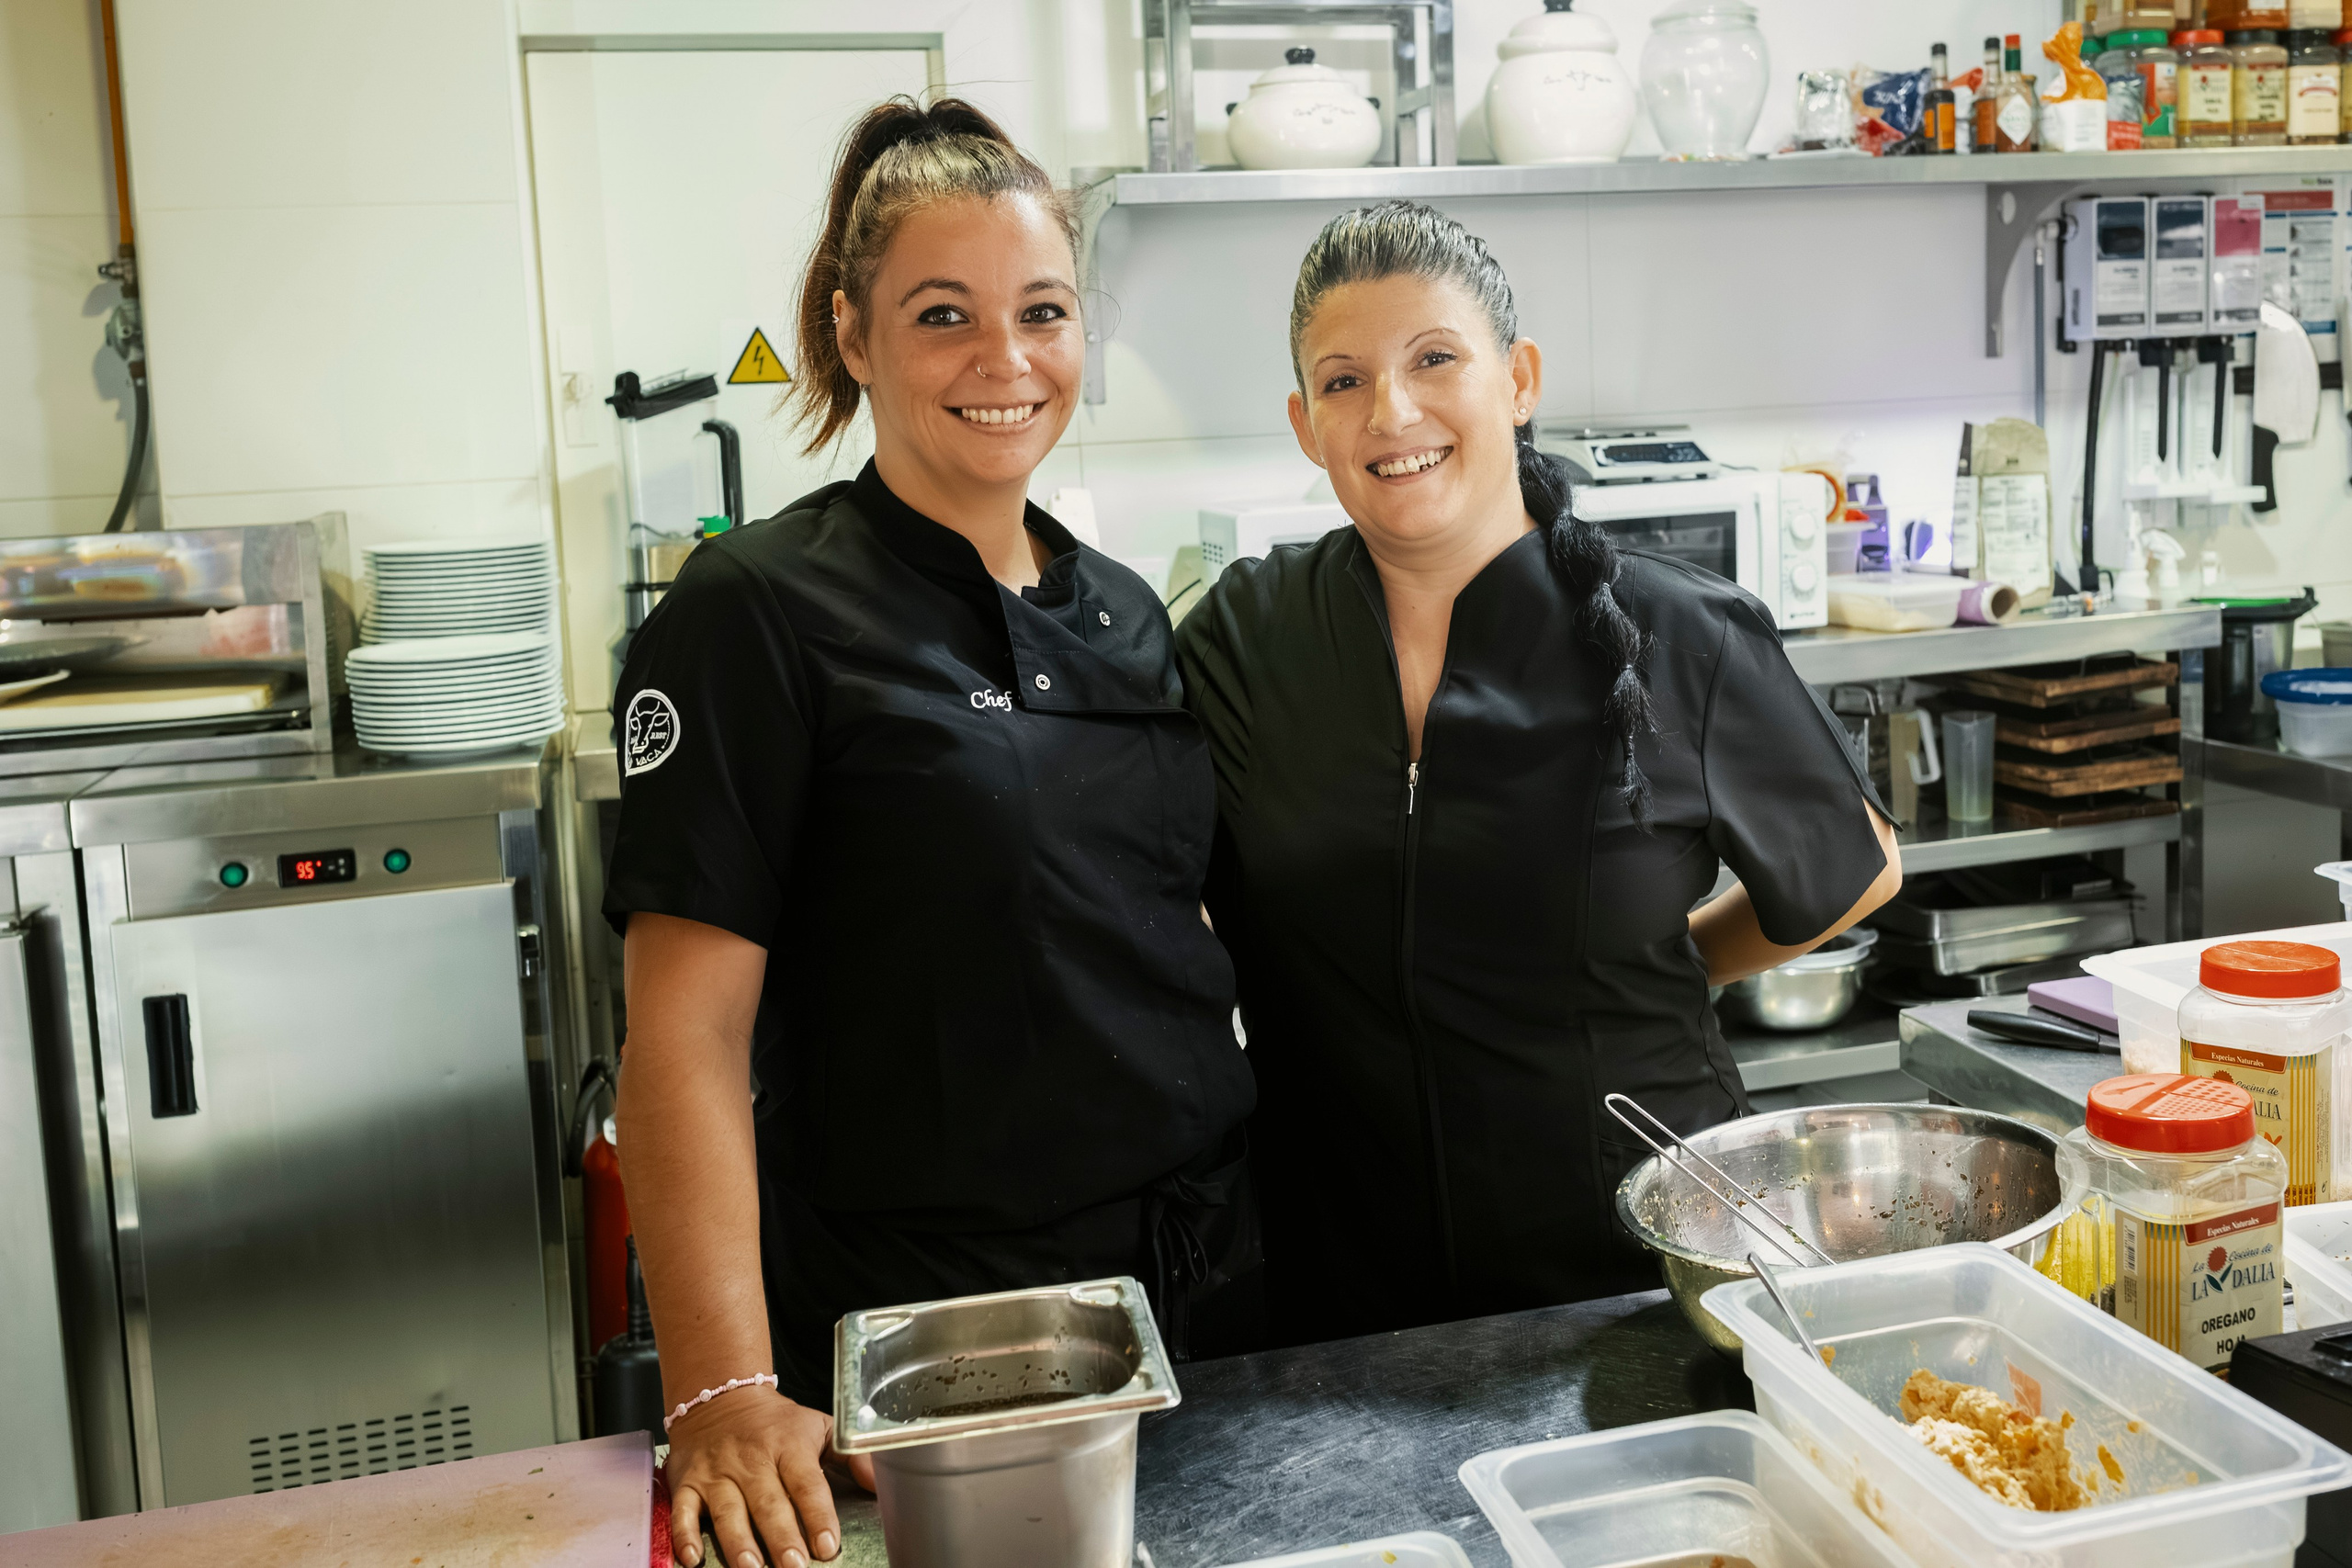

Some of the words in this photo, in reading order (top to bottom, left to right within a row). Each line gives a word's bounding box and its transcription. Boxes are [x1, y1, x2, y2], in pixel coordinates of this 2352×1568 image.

[970, 689, 1012, 712] Chef
[636, 749, 662, 766] VACA
[2211, 1052, 2236, 1063] Especias
[2236, 1056, 2264, 1067] Naturales
[2267, 1085, 2279, 1096] de
[2207, 1224, 2231, 1237] Especias
[2232, 1217, 2260, 1232] Naturales
[2191, 1261, 2205, 1274] La
[2228, 1247, 2260, 1262] Cocina
[2261, 1243, 2273, 1255] de
[2191, 1280, 2208, 1302] LA
[2233, 1261, 2276, 1290] DALIA
[2201, 1307, 2256, 1334] OREGANO
